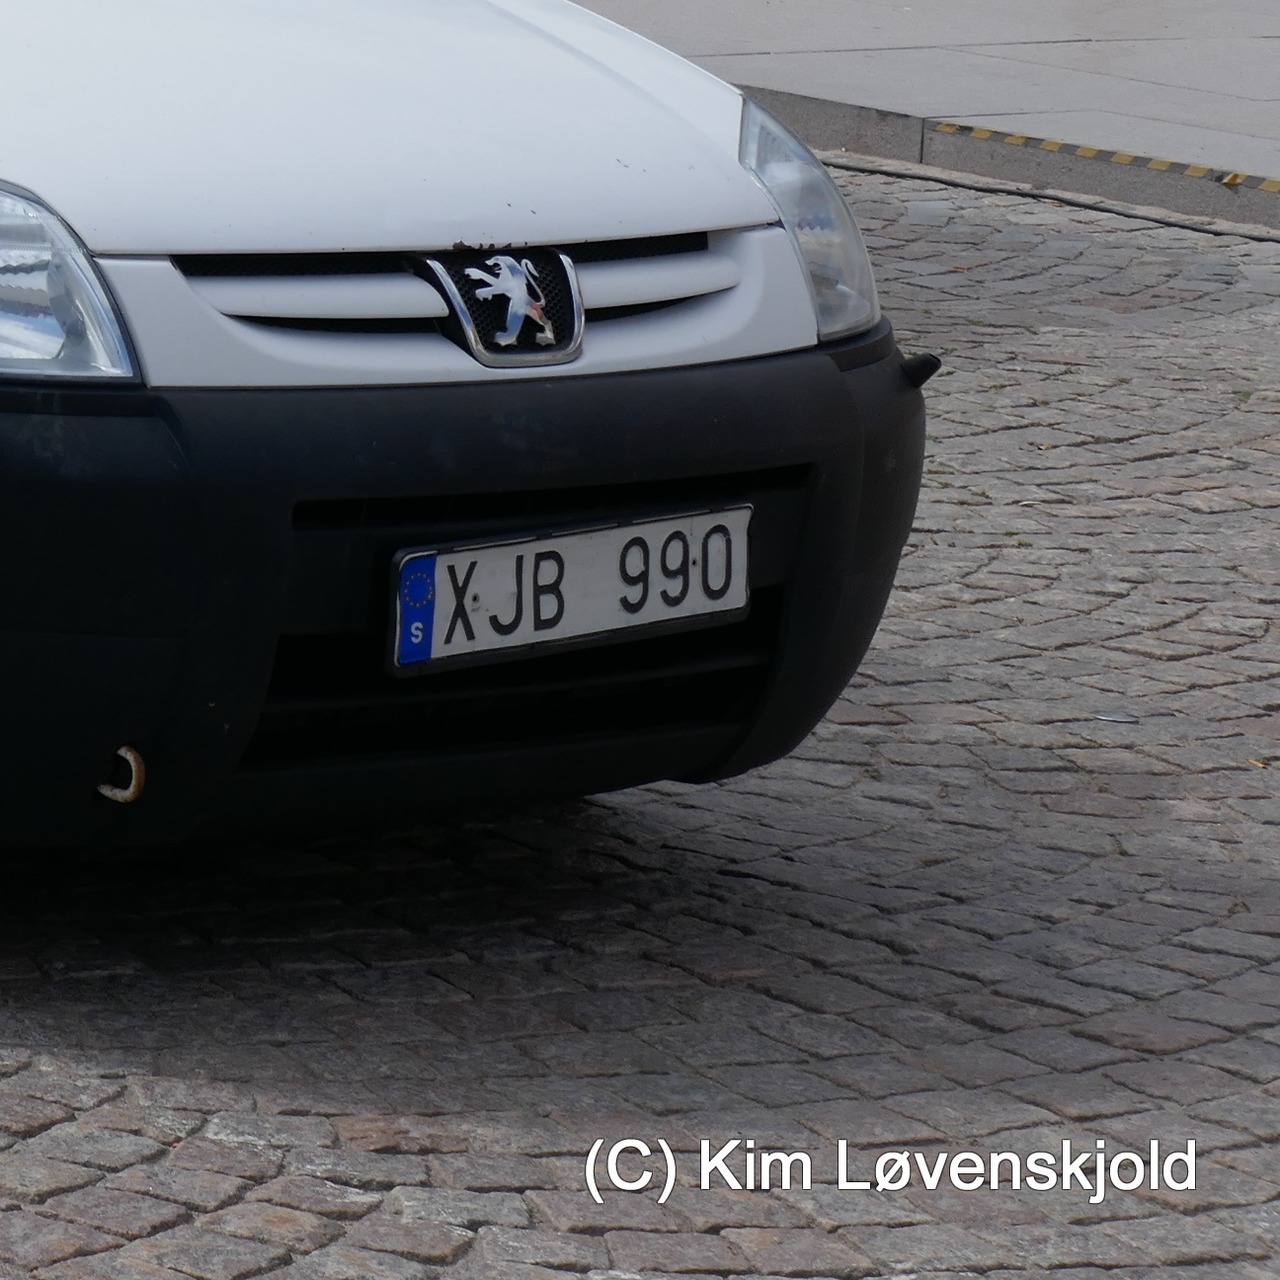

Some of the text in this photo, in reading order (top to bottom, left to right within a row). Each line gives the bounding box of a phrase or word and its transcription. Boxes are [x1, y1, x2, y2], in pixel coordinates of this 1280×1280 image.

[443, 524, 732, 645] XJB 990
[410, 622, 424, 644] S
